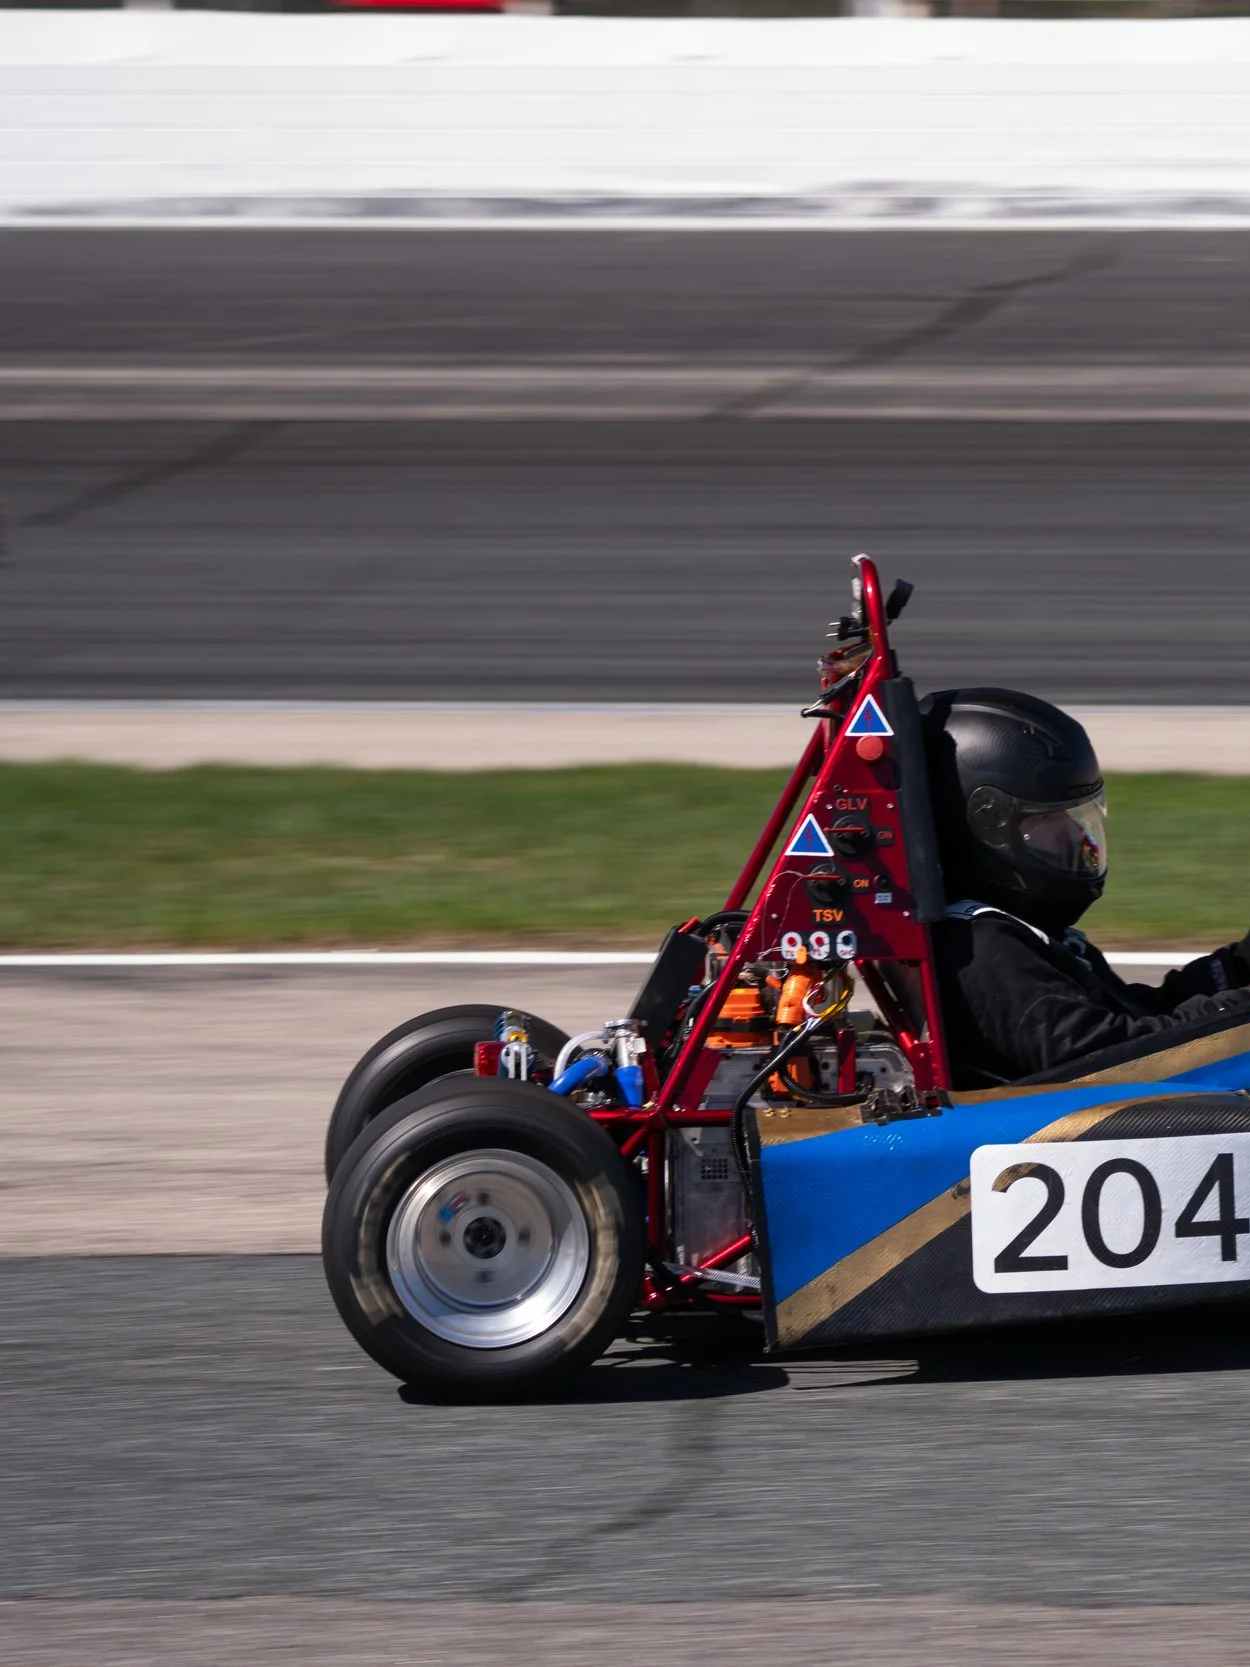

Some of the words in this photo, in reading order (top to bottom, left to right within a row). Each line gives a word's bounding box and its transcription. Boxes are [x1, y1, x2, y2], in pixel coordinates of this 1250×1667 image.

[835, 798, 868, 810] GLV
[813, 909, 844, 922] TSV
[991, 1153, 1250, 1274] 204
